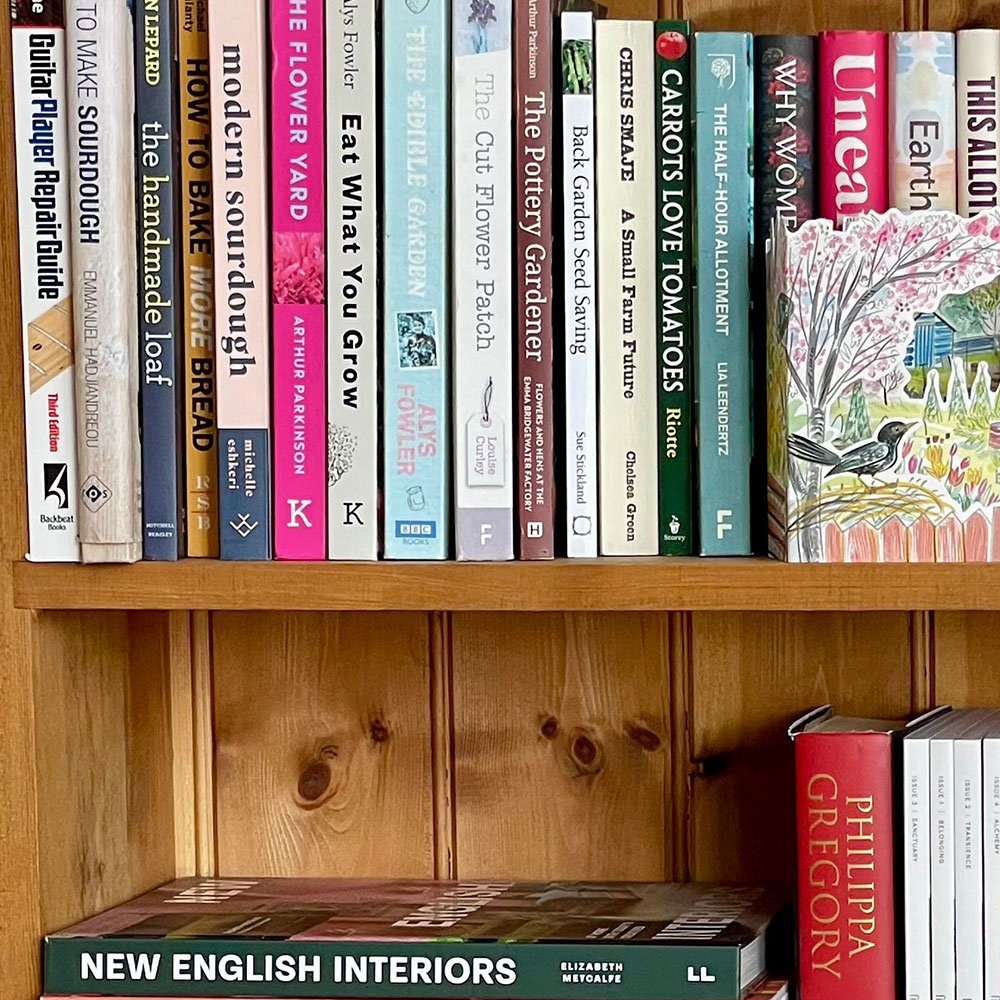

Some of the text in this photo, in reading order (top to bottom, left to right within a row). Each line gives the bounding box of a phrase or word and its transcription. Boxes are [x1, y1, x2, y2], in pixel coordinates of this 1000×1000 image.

[78, 105, 99, 448] SOURDOUGH EMMANUEL HADJIANDREOU
[142, 15, 171, 386] LEPARD the handmade loaf
[186, 59, 214, 451] HOW TO BAKE MORE BREAD
[221, 45, 255, 378] modern sourdough
[289, 42, 309, 475] FLOWER YARD ARTHUR PARKINSON
[341, 114, 362, 410] Eat What You Grow
[474, 74, 495, 351] The Cut Flower Patch
[518, 92, 546, 362] The Pottery Gardener
[570, 126, 590, 504] Back Garden Seed Saving Stickland
[620, 48, 637, 399] CHRIS SMAJE Small Farm Future
[661, 70, 683, 458] CARROTS LOVE TOMATOES Riotte
[714, 104, 729, 455] THE HALF-HOUR ALLOTMENT LIA LEENDERTZ
[47, 394, 60, 452] Third Edition
[523, 376, 533, 512] EMMA BRIDGEWATER FACTORY
[81, 953, 517, 985] NEW ENGLISH INTERIORS
[561, 963, 623, 971] ELIZABETH
[562, 975, 621, 983] METCALFE
[806, 773, 841, 978] GREGORY
[845, 795, 875, 958] PHILIPPA
